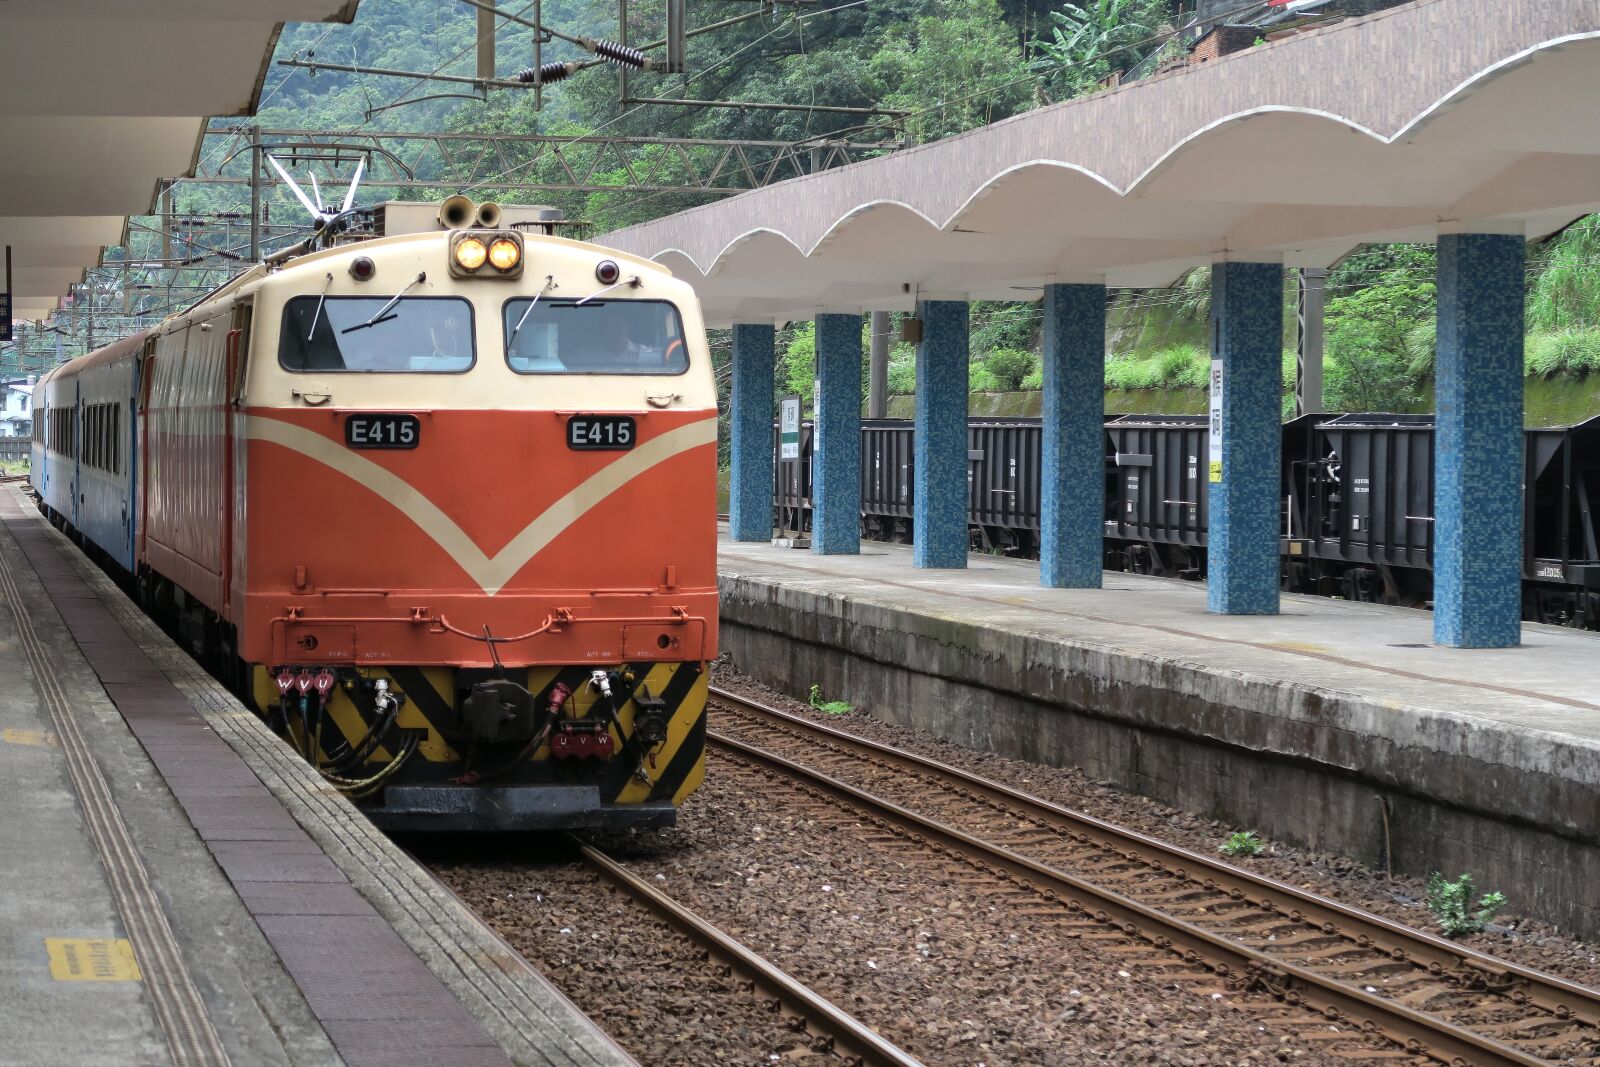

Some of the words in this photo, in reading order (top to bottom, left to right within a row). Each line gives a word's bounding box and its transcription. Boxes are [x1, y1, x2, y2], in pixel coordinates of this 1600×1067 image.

[352, 420, 414, 443] E415
[572, 422, 630, 444] E415
[278, 678, 292, 688] W
[300, 679, 309, 690] V
[319, 679, 328, 688] U
[560, 737, 567, 745] U
[580, 737, 586, 745] V
[598, 736, 608, 745] W
